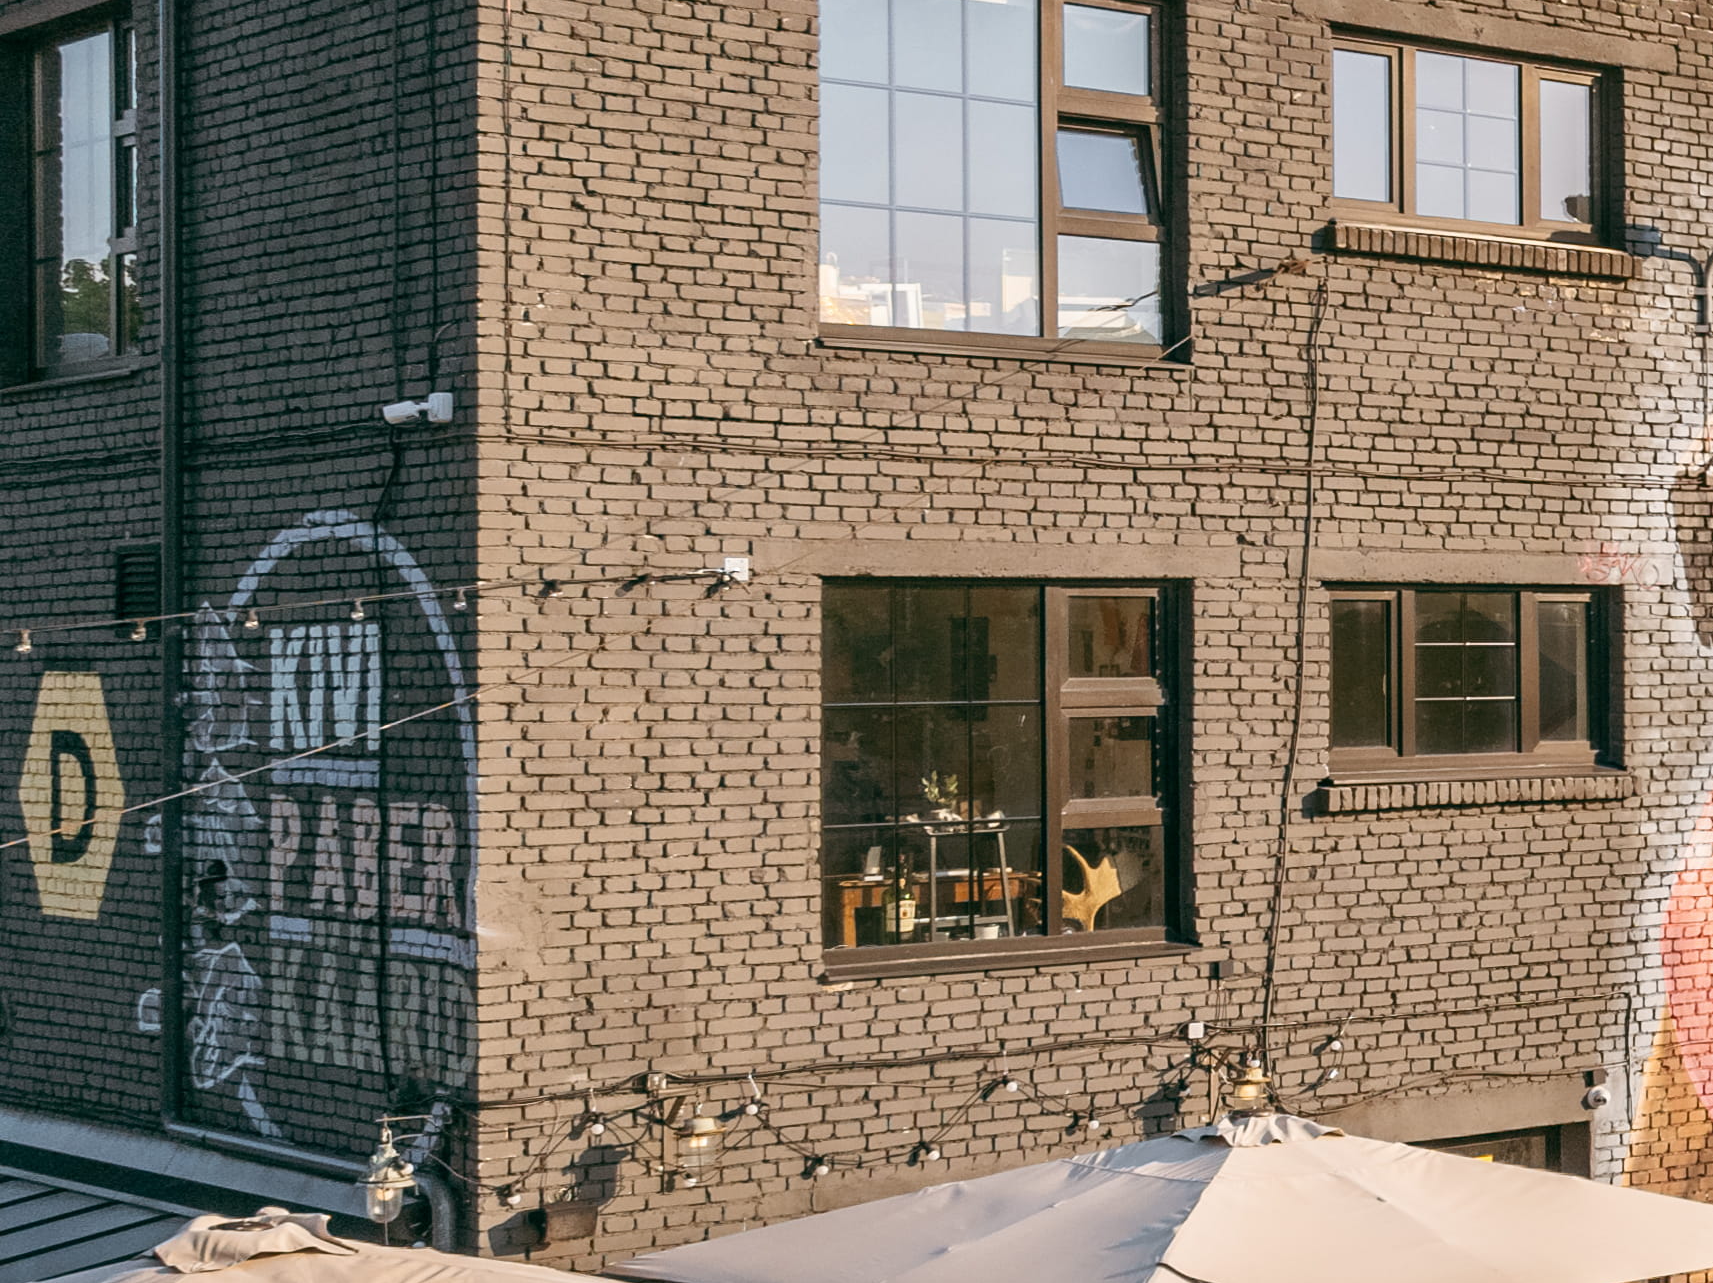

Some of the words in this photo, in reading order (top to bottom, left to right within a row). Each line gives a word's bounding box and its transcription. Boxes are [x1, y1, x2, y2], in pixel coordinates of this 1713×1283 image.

[269, 624, 380, 751] KIVI
[50, 731, 98, 864] D
[269, 793, 460, 927] PABER
